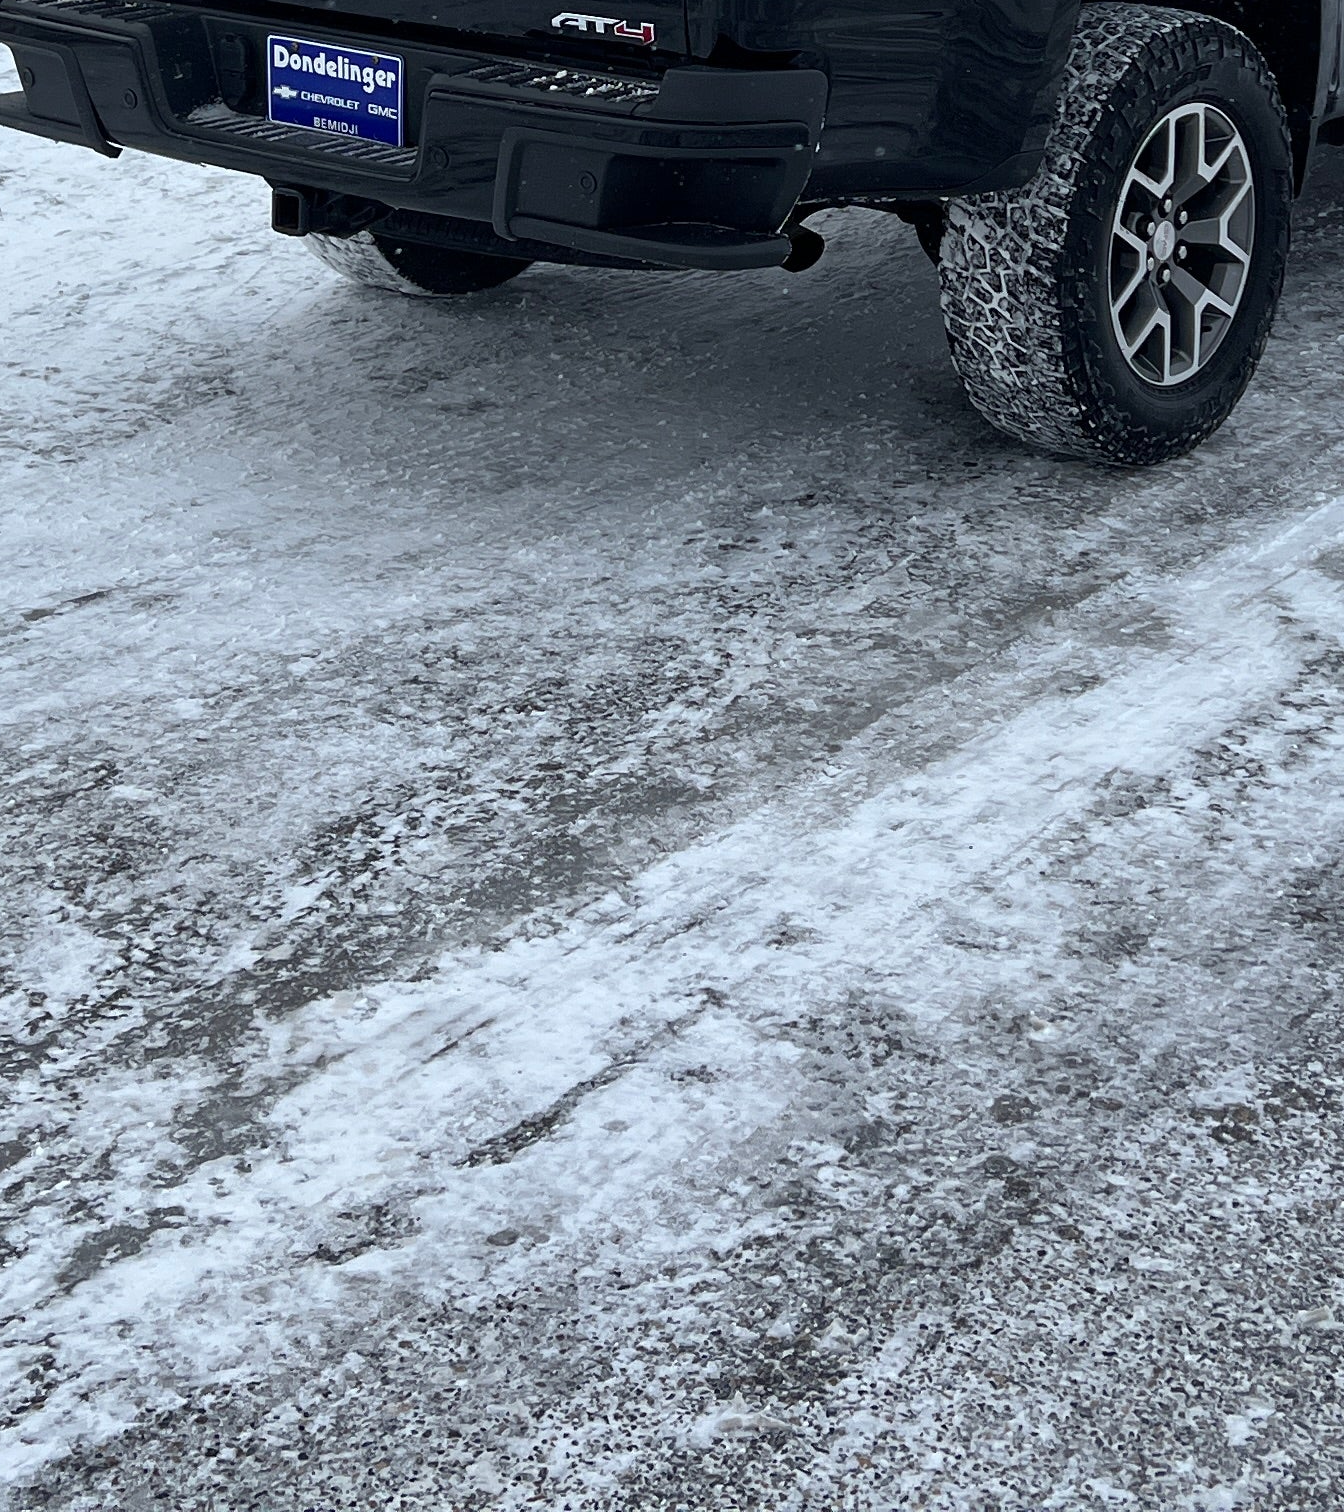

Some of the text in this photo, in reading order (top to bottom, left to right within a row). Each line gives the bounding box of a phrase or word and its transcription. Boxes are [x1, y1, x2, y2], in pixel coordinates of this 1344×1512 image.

[552, 12, 655, 45] AT4
[273, 44, 396, 94] Dondelinger
[300, 90, 398, 120] CHEVROLET GMC
[313, 116, 359, 135] BEMIDJI
